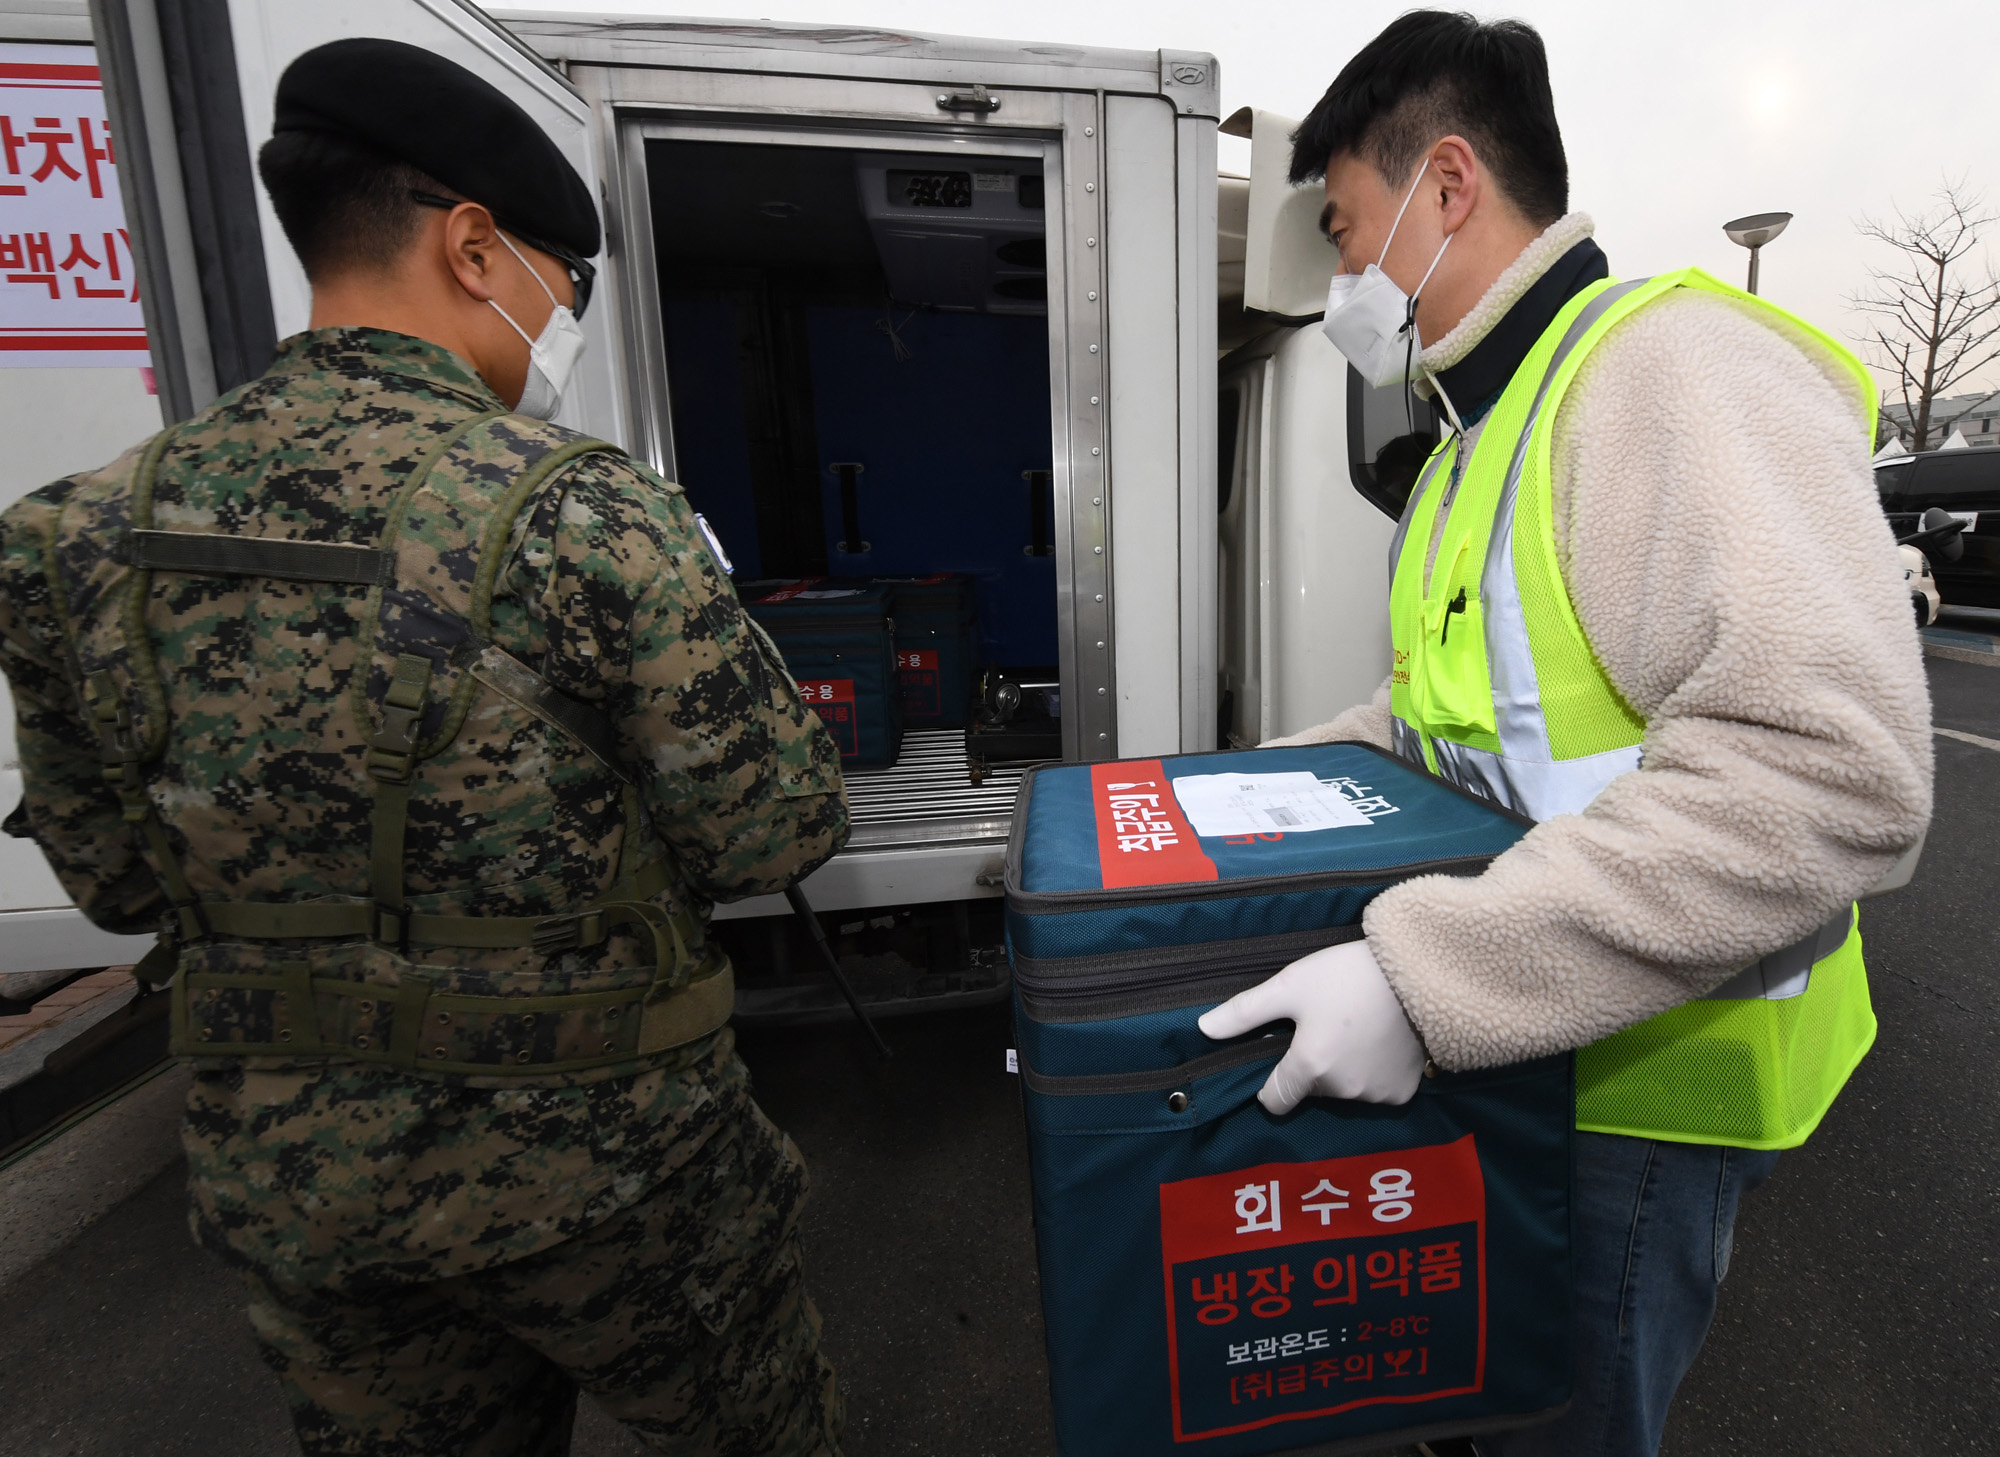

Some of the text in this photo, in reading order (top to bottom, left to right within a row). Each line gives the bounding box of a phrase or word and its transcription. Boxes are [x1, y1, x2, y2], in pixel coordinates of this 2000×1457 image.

[813, 706, 849, 722] 약품
[1109, 794, 1179, 853] 취급주의
[1191, 1240, 1462, 1326] 냉장 의약품
[1226, 1328, 1330, 1365] 보관온도
